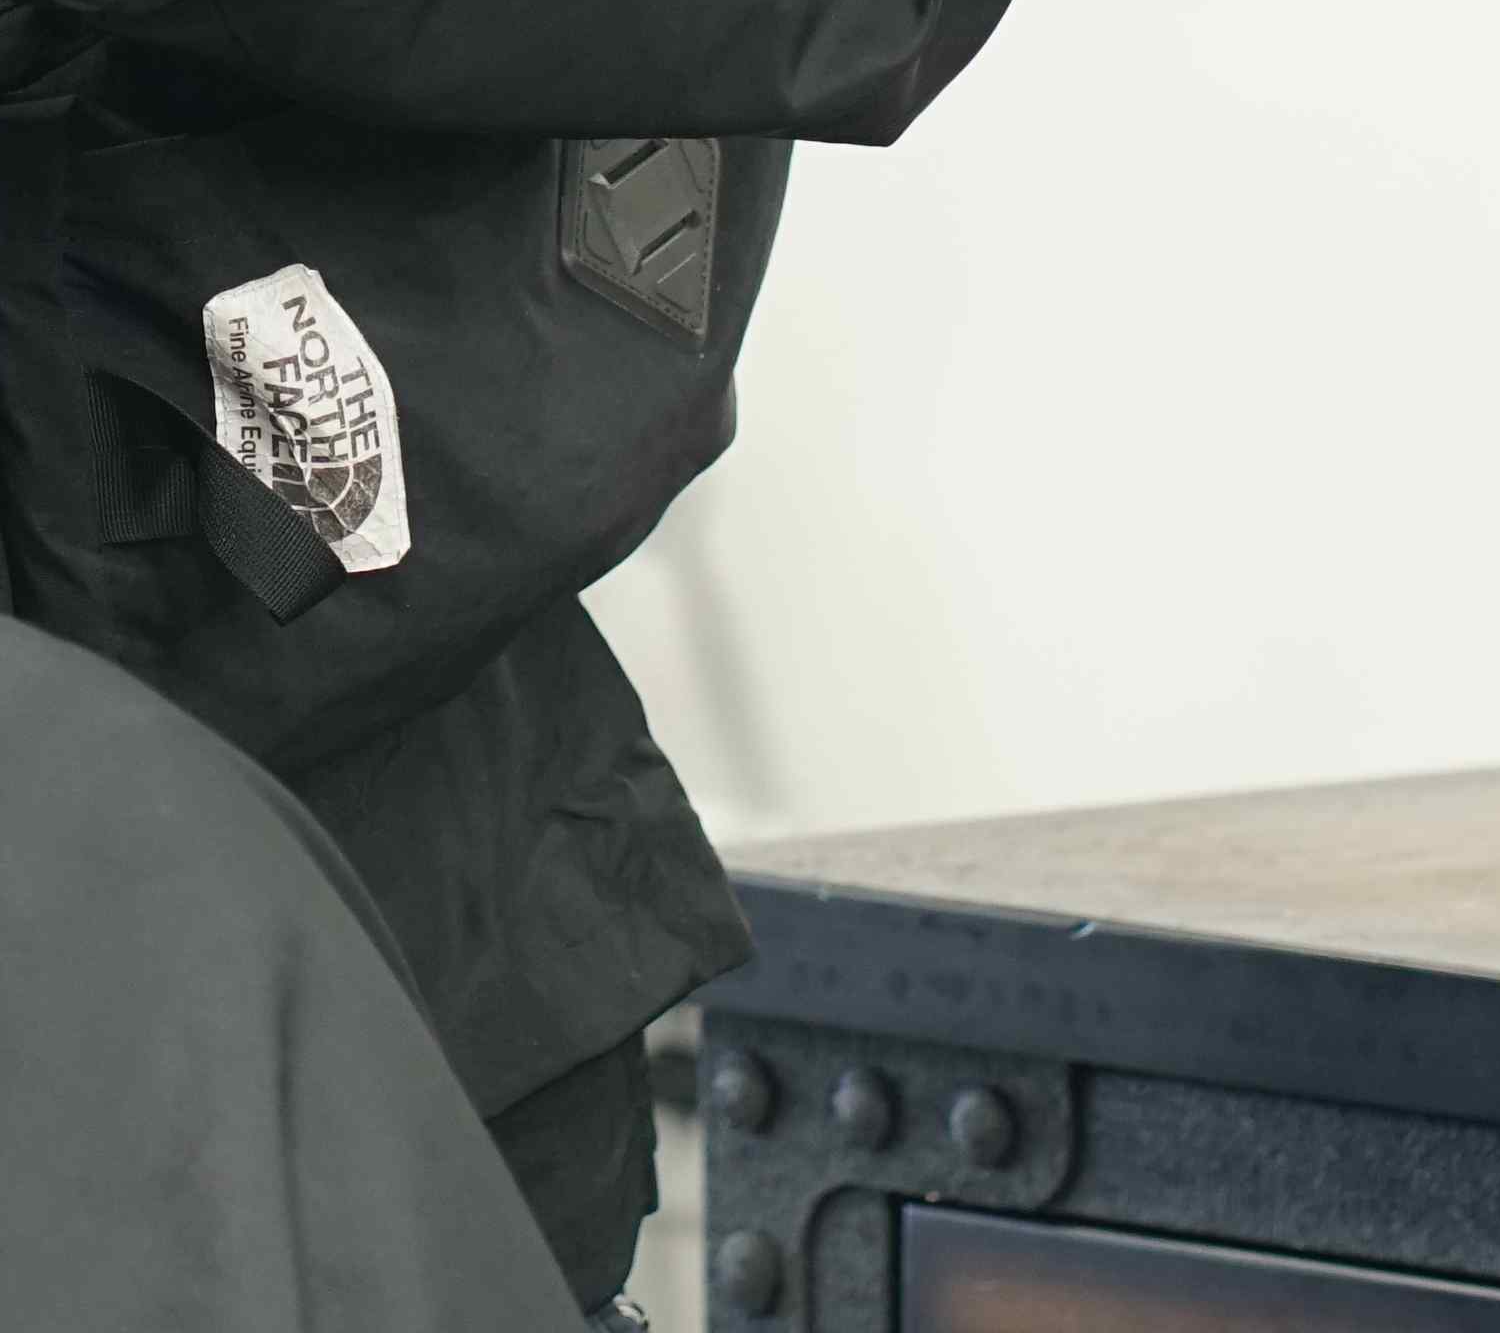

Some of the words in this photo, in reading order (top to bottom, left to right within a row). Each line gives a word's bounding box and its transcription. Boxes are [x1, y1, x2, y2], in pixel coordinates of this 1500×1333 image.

[228, 316, 250, 363] Fine
[283, 295, 349, 464] NORTH
[262, 354, 308, 463] FACE
[341, 356, 381, 459] THE
